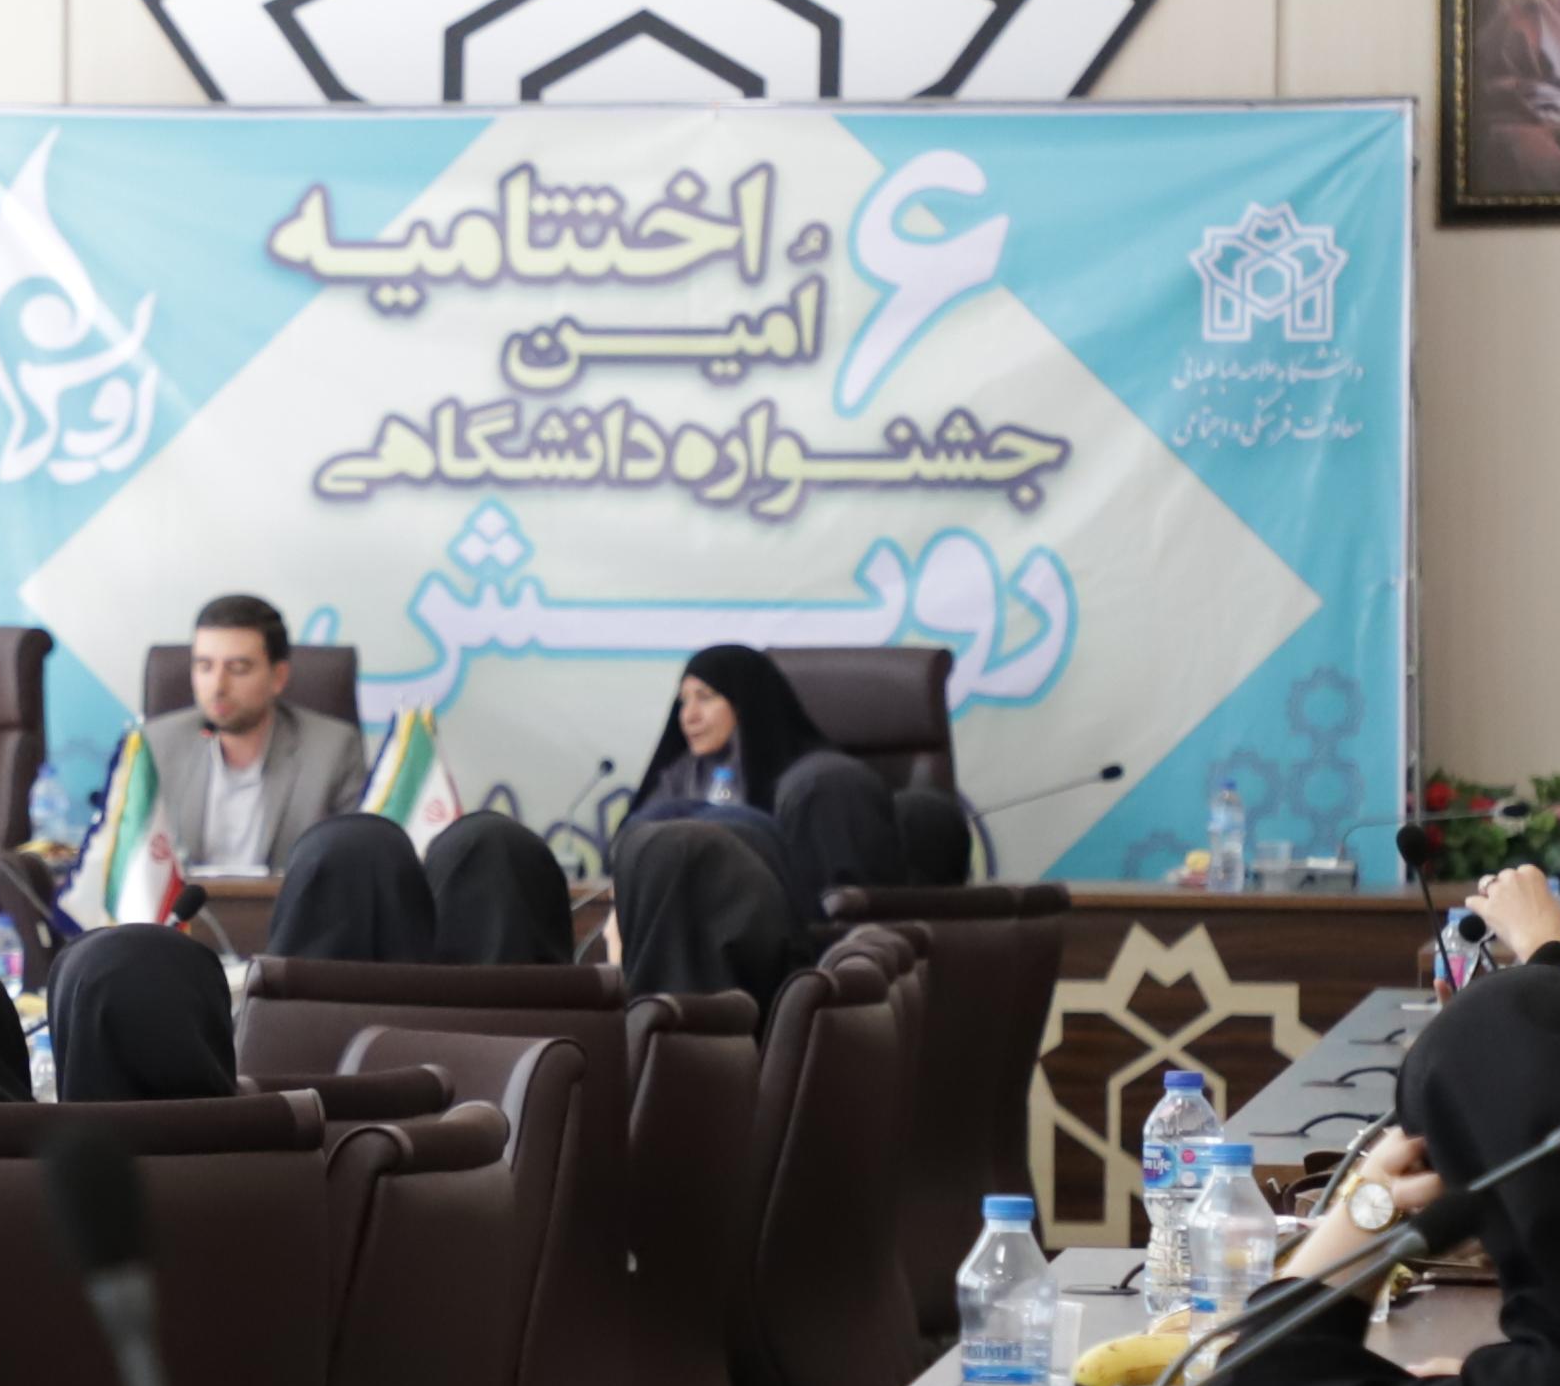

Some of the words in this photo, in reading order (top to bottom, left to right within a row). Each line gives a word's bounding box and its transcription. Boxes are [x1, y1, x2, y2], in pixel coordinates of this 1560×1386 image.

[266, 161, 775, 318] اختتامیه
[312, 396, 671, 506] دانشگاهی
[674, 398, 1072, 521] جشنواره
